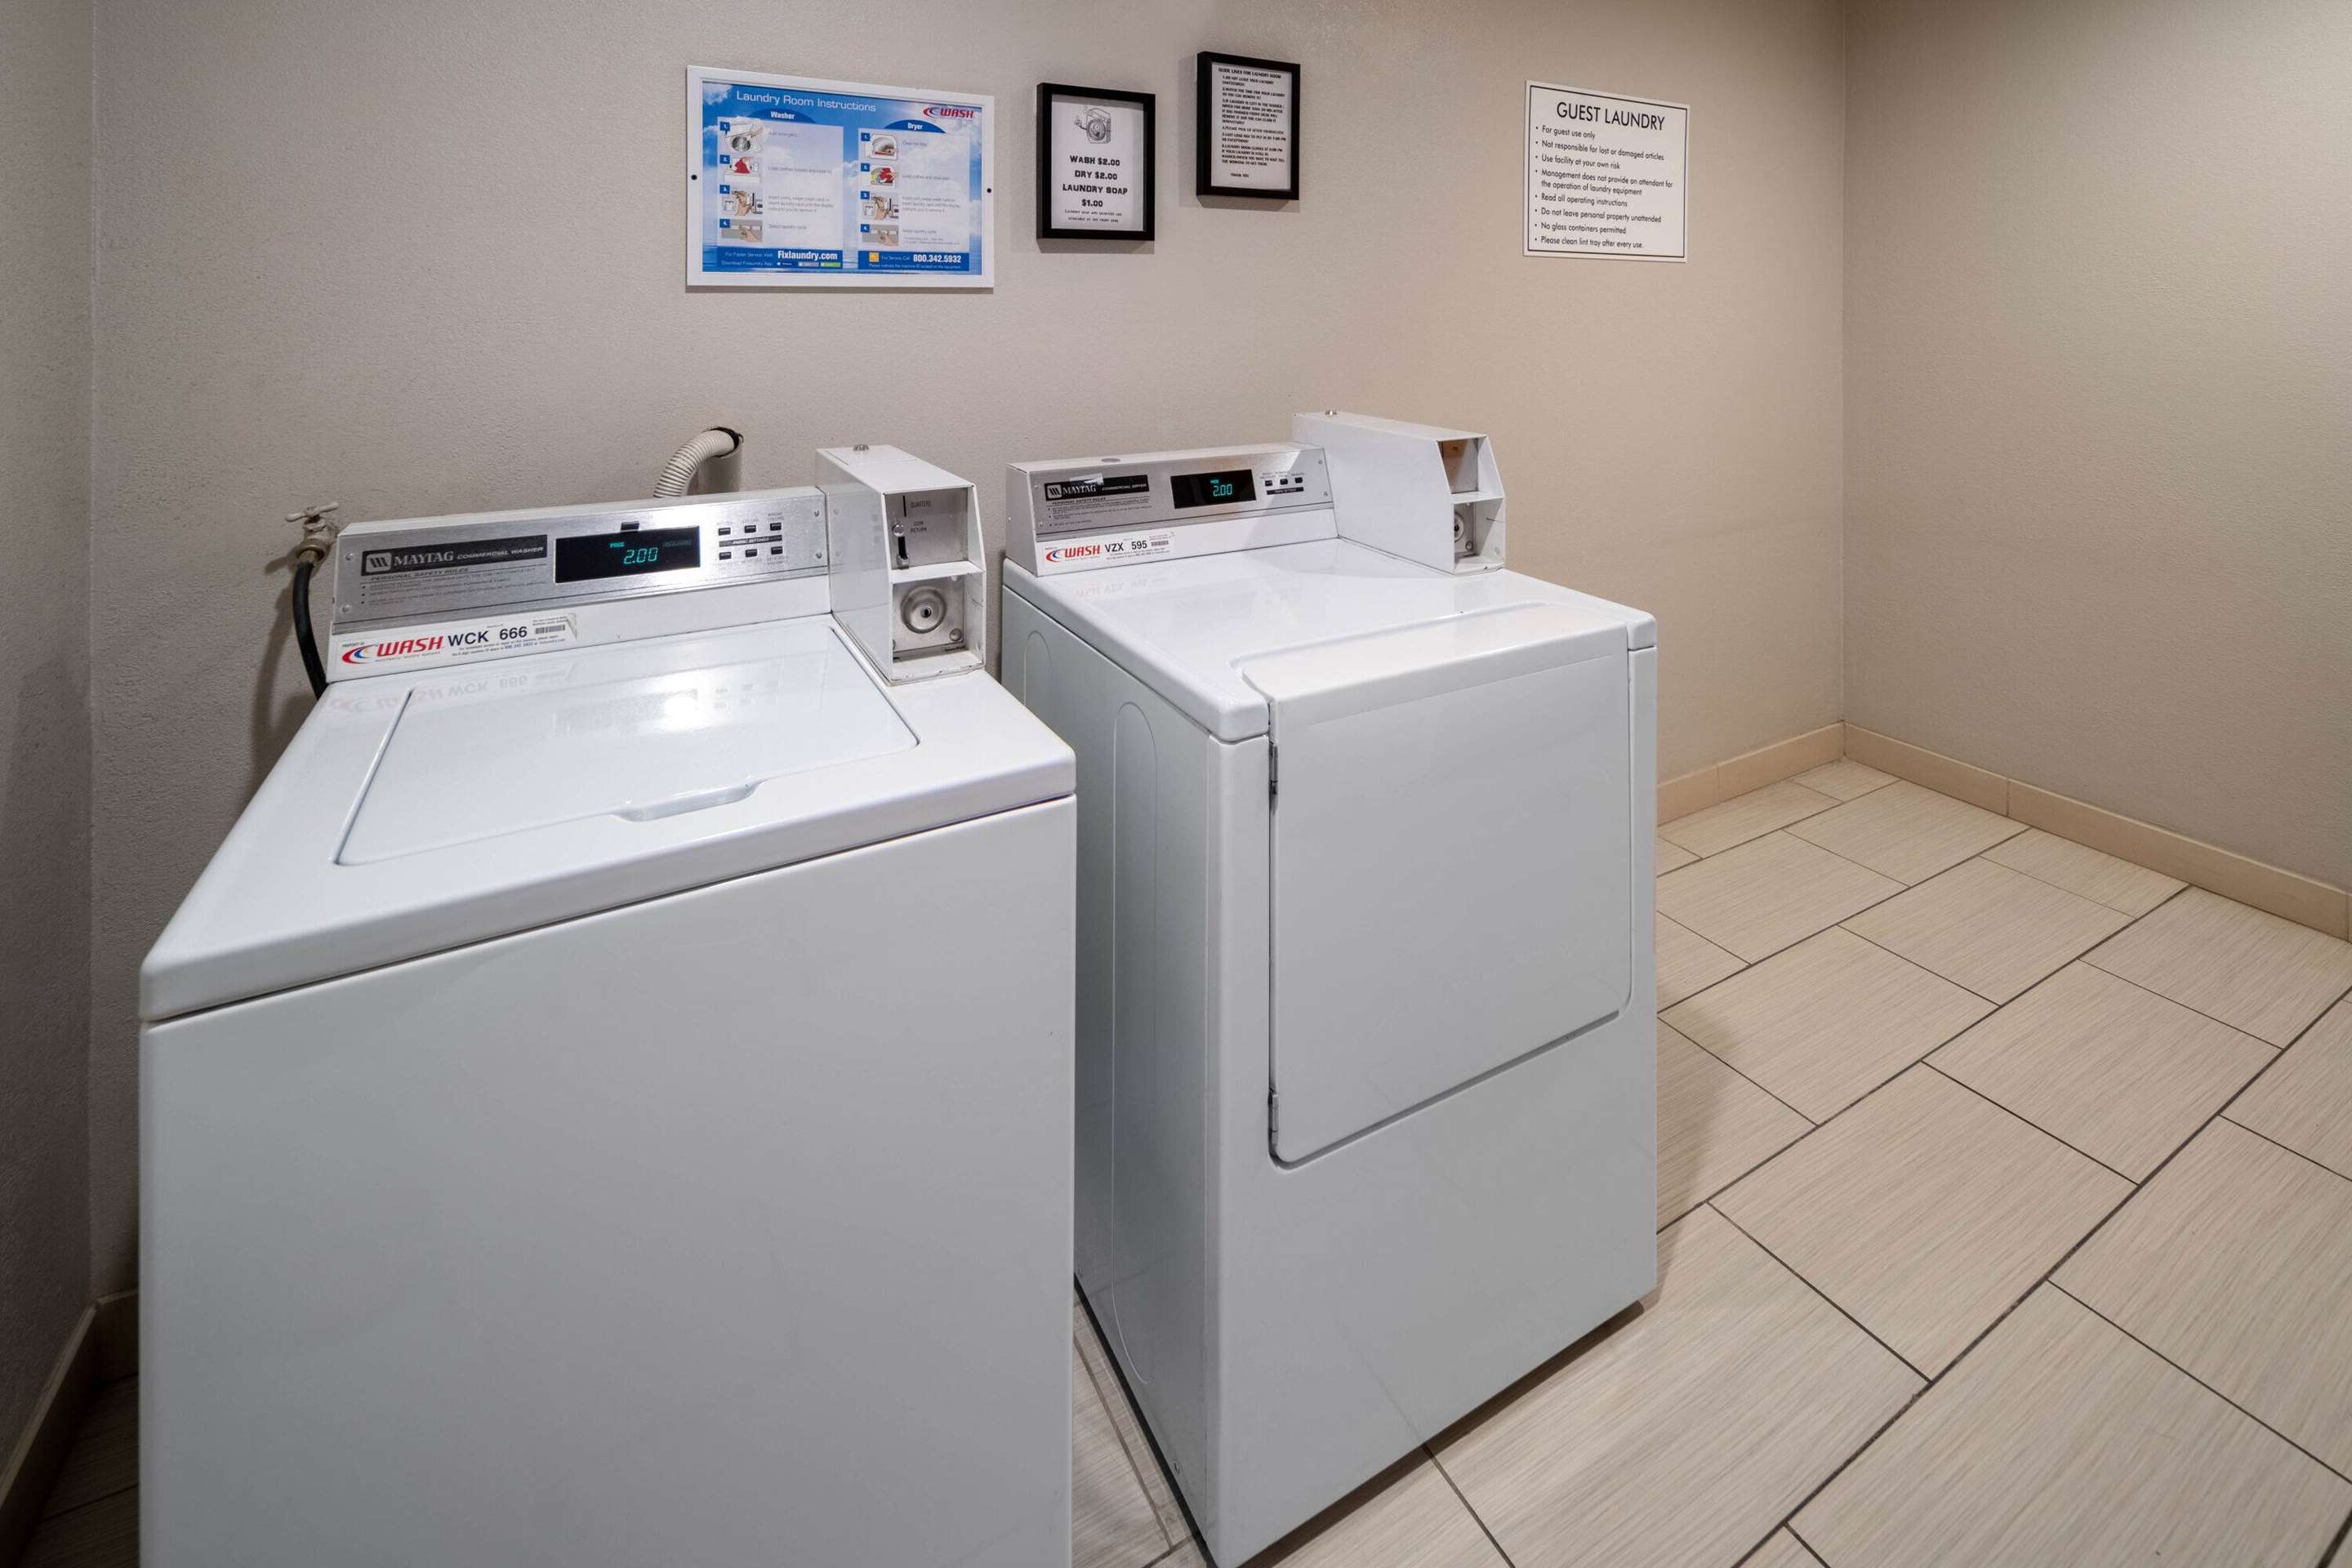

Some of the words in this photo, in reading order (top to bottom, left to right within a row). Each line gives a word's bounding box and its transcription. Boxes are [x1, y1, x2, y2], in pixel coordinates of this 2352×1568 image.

[737, 91, 781, 105] Laundry
[783, 95, 814, 107] Room
[817, 98, 875, 112] Instructions
[771, 111, 795, 120] Washer
[940, 107, 973, 118] WASH
[1557, 102, 1600, 122] GUEST
[1605, 109, 1664, 131] LAUNDRY
[908, 122, 922, 131] Dryer
[1543, 125, 1552, 133] For
[1554, 127, 1570, 136] guest
[1584, 131, 1595, 140] only
[1555, 142, 1588, 152] responsible
[1619, 149, 1644, 159] damaged
[1646, 152, 1664, 160] articles
[1070, 155, 1095, 164] WASH
[1098, 158, 1120, 166] $2.00
[1555, 156, 1574, 166] facility
[1075, 170, 1092, 178] DRY
[1542, 170, 1580, 180] Management
[1609, 175, 1628, 185] provide
[1639, 178, 1664, 187] attendant
[1062, 184, 1102, 193] LAUNDRY
[1542, 180, 1551, 188] the
[1552, 181, 1580, 191] operation
[1590, 184, 1611, 194] laundry
[1613, 187, 1642, 196] equipment
[1567, 196, 1594, 206] operating
[1597, 197, 1627, 207] instructions
[1563, 208, 1579, 217] leave
[1580, 211, 1605, 220] personal
[1606, 212, 1629, 221] property
[1631, 215, 1661, 223] unattended
[1552, 223, 1567, 232] glass
[1569, 225, 1598, 233] containers
[1600, 226, 1626, 234] permitted
[1541, 236, 1560, 244] Please
[1561, 237, 1578, 245] clean
[1590, 239, 1601, 247] tray
[1602, 239, 1615, 247] after
[777, 251, 837, 261] Fixlaundry.com
[913, 255, 961, 263] 800.342.5932
[1062, 485, 1096, 495] MAYTAG
[1214, 484, 1232, 497] 2.00
[1065, 545, 1100, 558] WASH
[1105, 542, 1124, 552] VZX
[1132, 540, 1147, 550] 595
[394, 551, 454, 567] MAYTAG
[511, 546, 543, 555] WASHER
[624, 547, 658, 564] 2.00
[376, 635, 443, 657] WASH
[448, 630, 489, 647] WCK
[499, 626, 528, 639] 666
